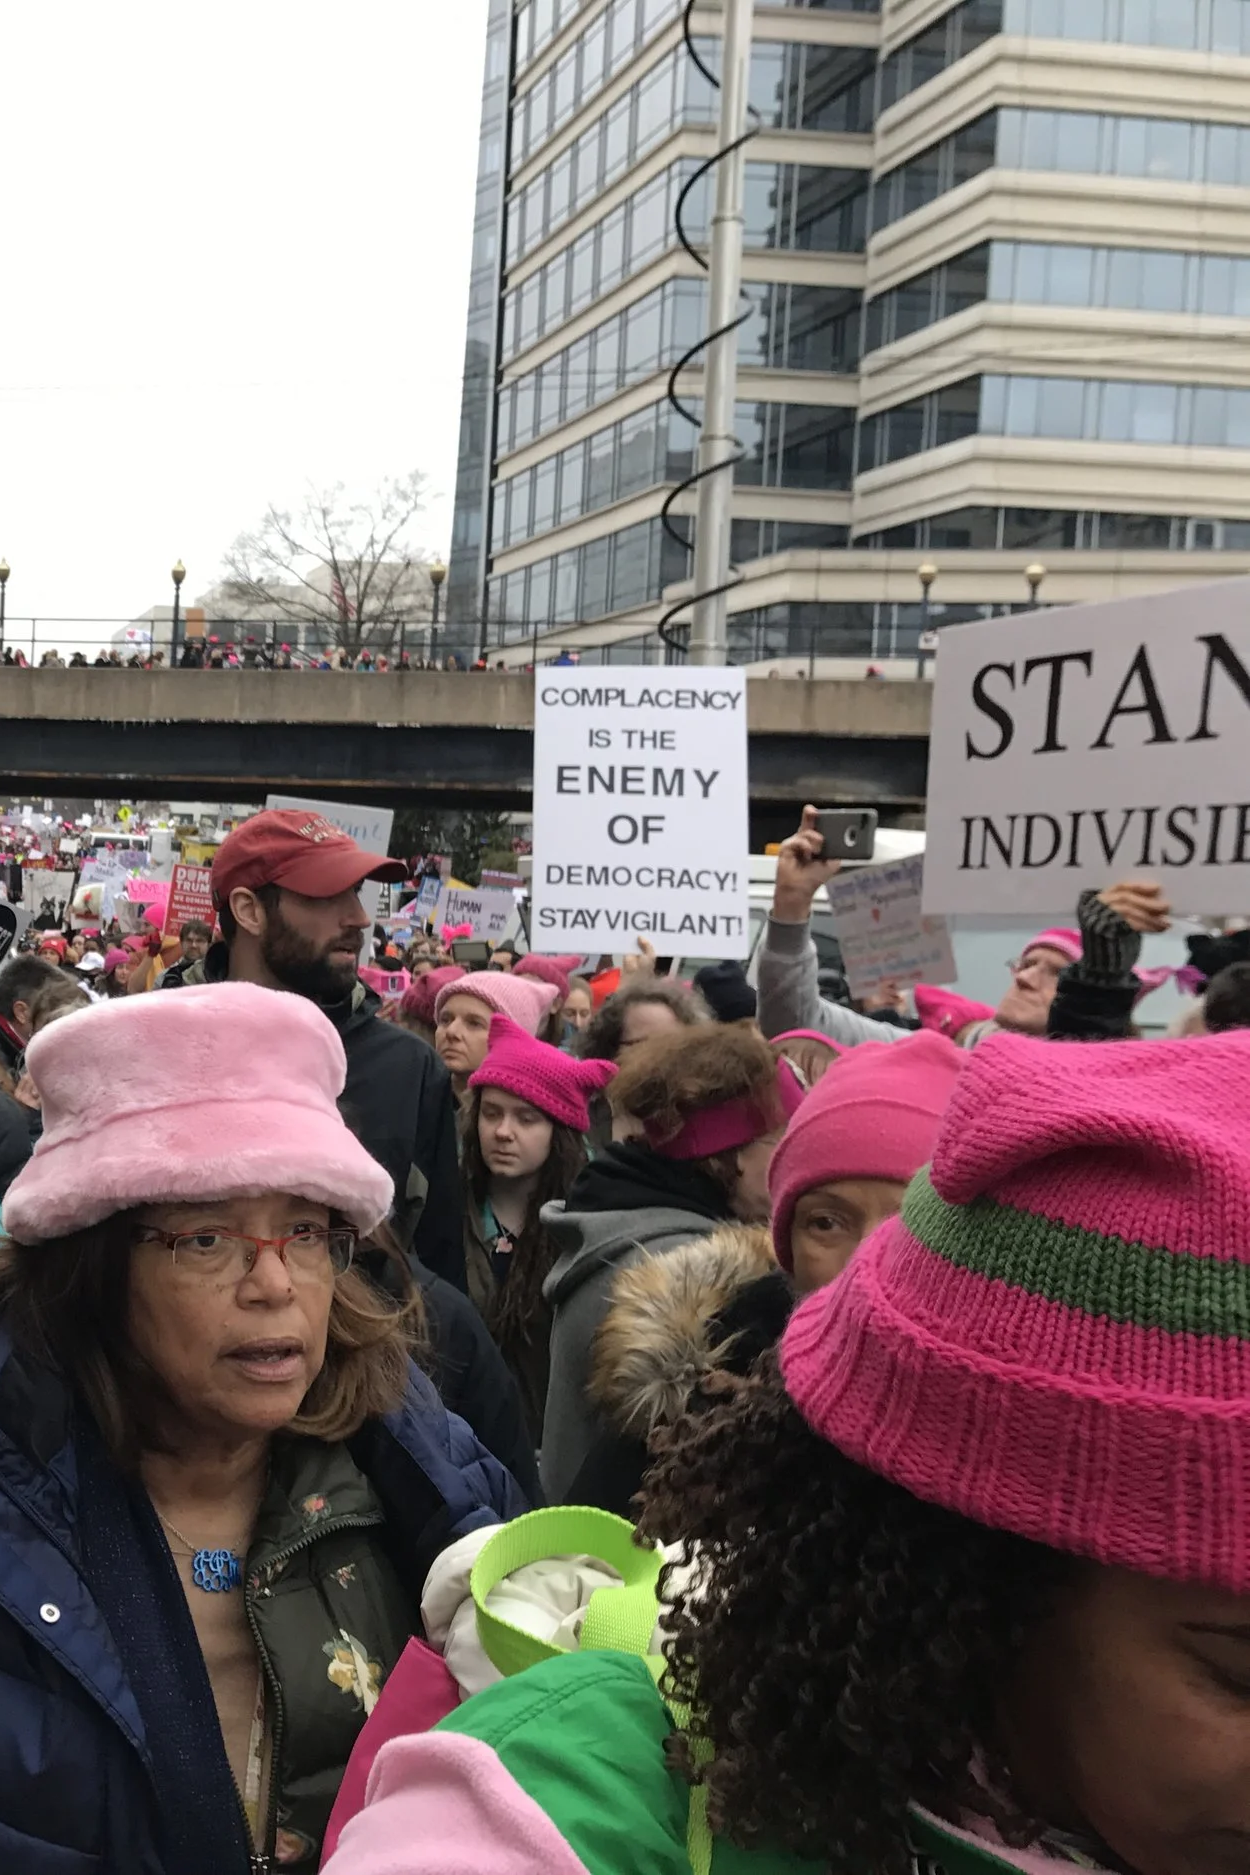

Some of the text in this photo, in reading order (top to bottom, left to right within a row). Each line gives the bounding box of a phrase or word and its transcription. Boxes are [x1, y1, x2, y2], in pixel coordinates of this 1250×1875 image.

[540, 686, 743, 711] COMPLACENCY
[588, 728, 676, 751] IS THE
[555, 765, 720, 800] ENEMY
[607, 814, 666, 845] OF
[545, 864, 738, 893] DEMOCRACY!
